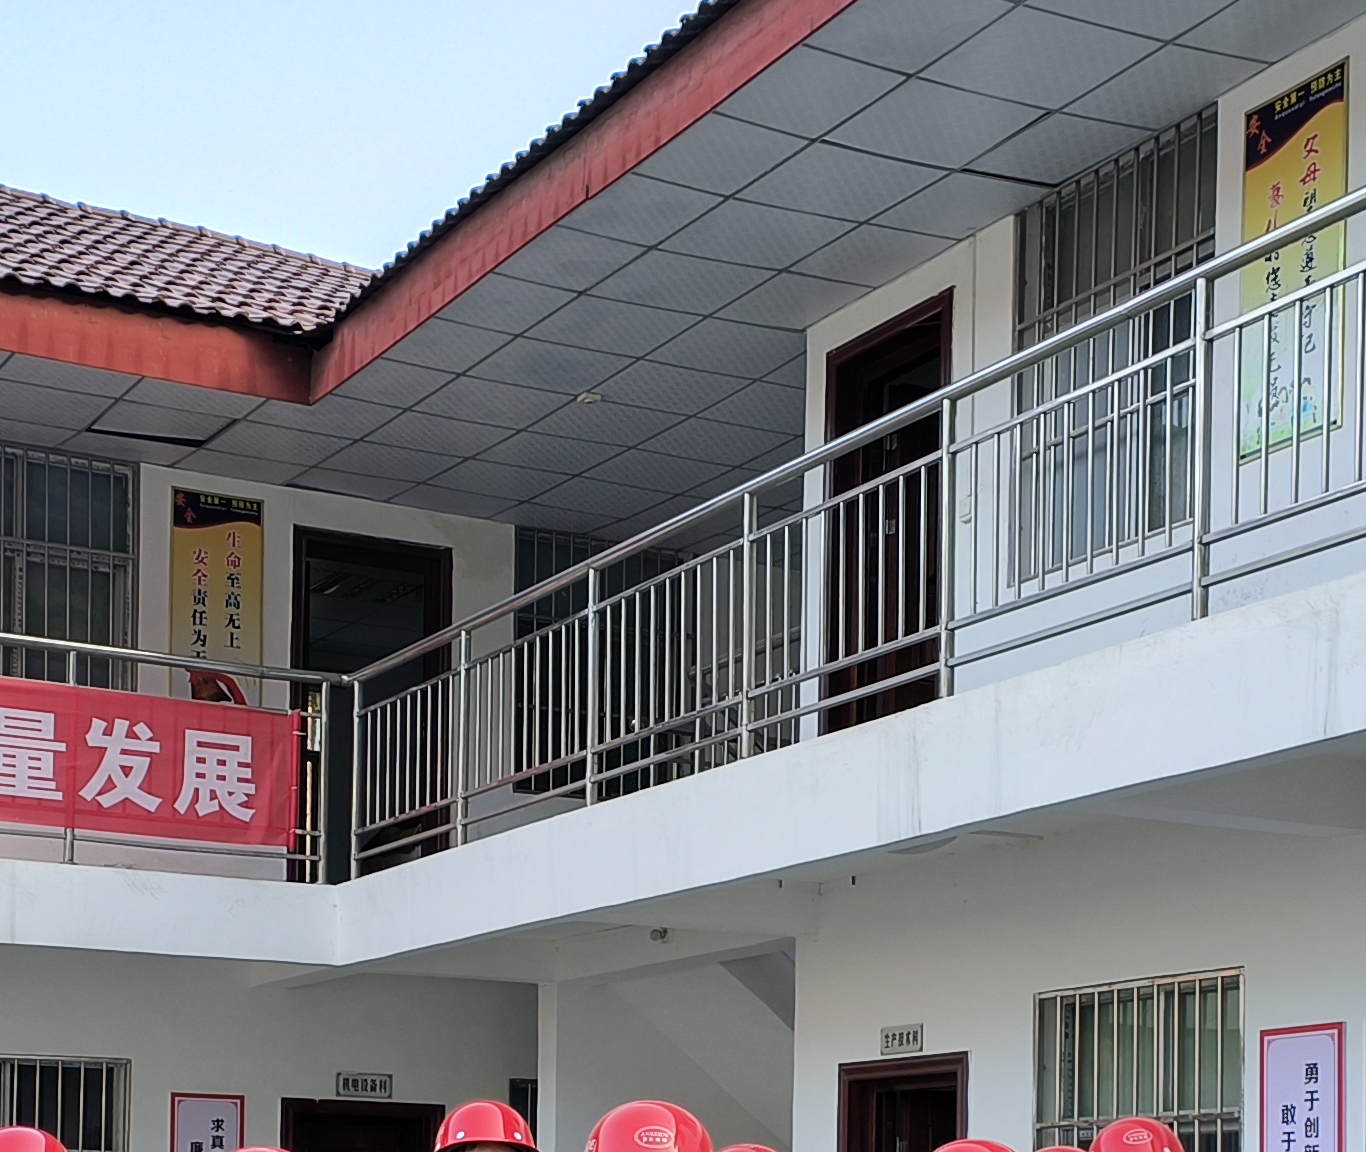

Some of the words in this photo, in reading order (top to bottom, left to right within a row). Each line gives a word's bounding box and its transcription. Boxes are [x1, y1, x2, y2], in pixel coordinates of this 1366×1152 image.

[224, 530, 242, 649] 生命至高无上
